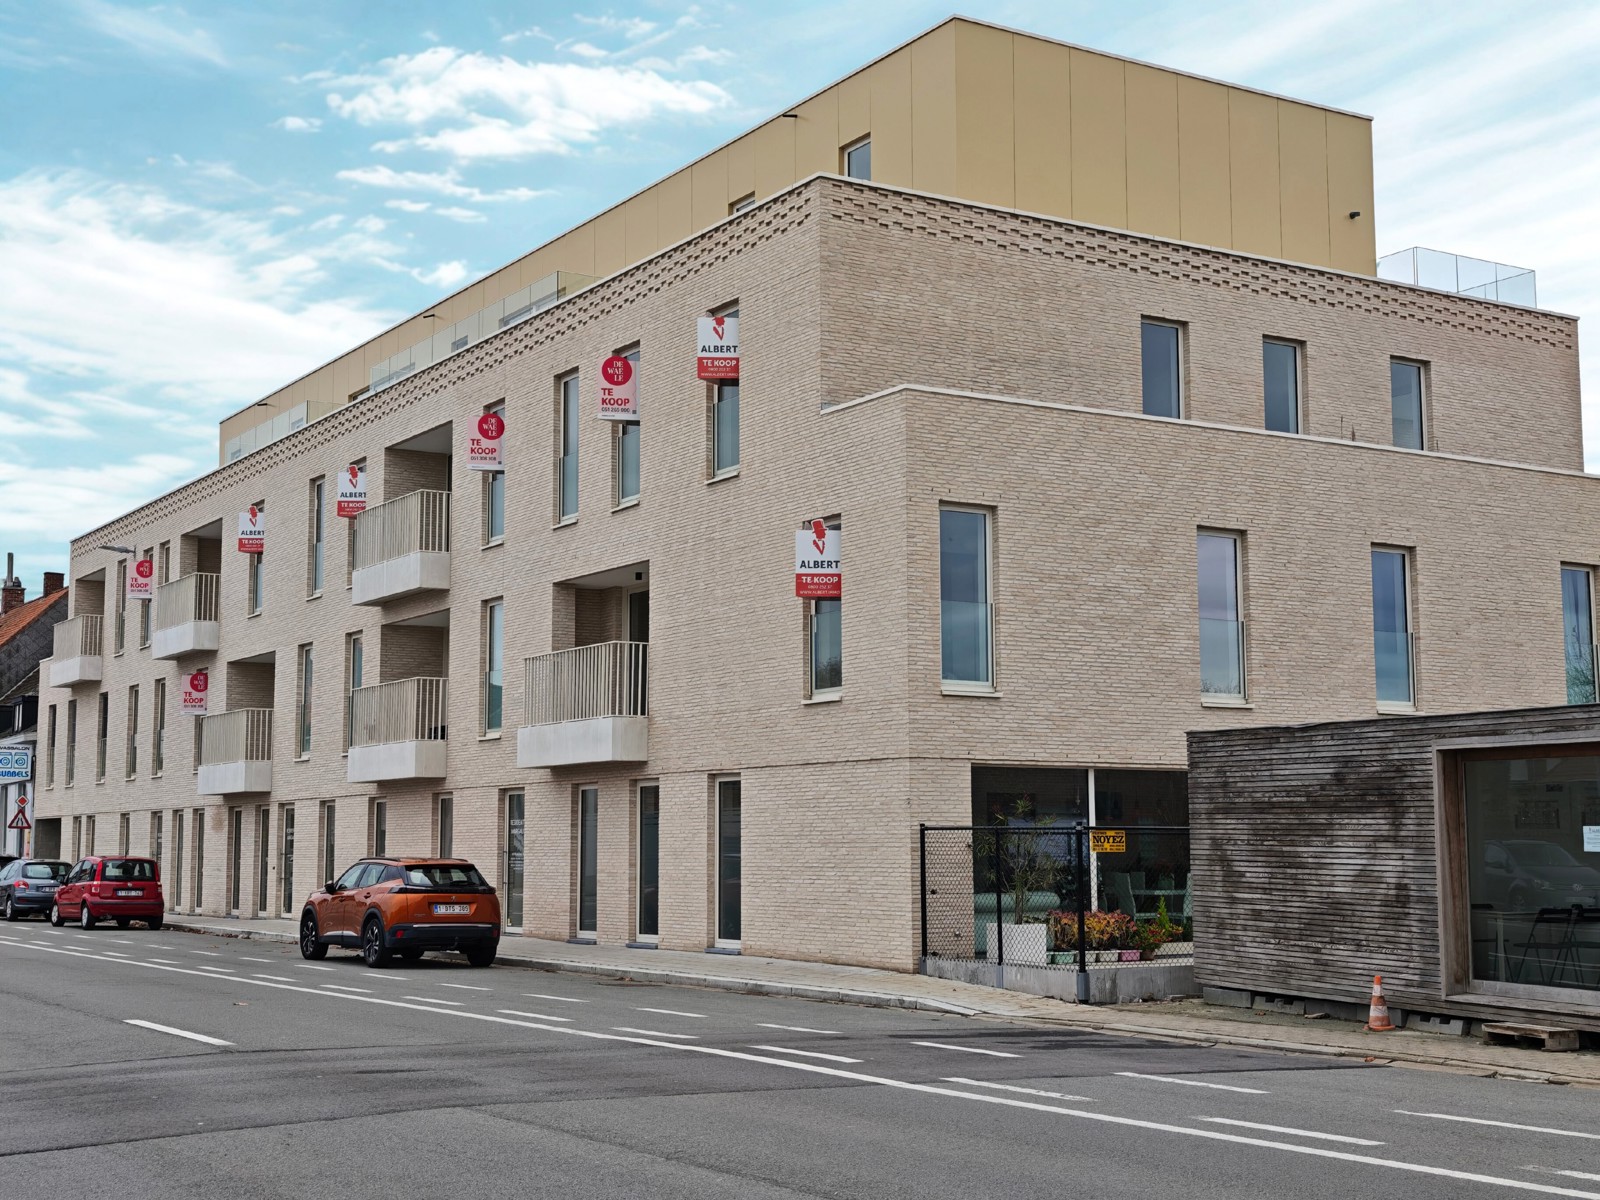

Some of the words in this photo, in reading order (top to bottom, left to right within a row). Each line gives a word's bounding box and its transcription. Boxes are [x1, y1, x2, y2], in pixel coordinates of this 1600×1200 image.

[701, 345, 738, 353] ALBERT
[601, 388, 613, 396] TE
[601, 398, 630, 406] KOOP
[470, 447, 497, 455] KOOP
[800, 560, 840, 569] ALBERT
[1092, 835, 1125, 843] NOYEZ
